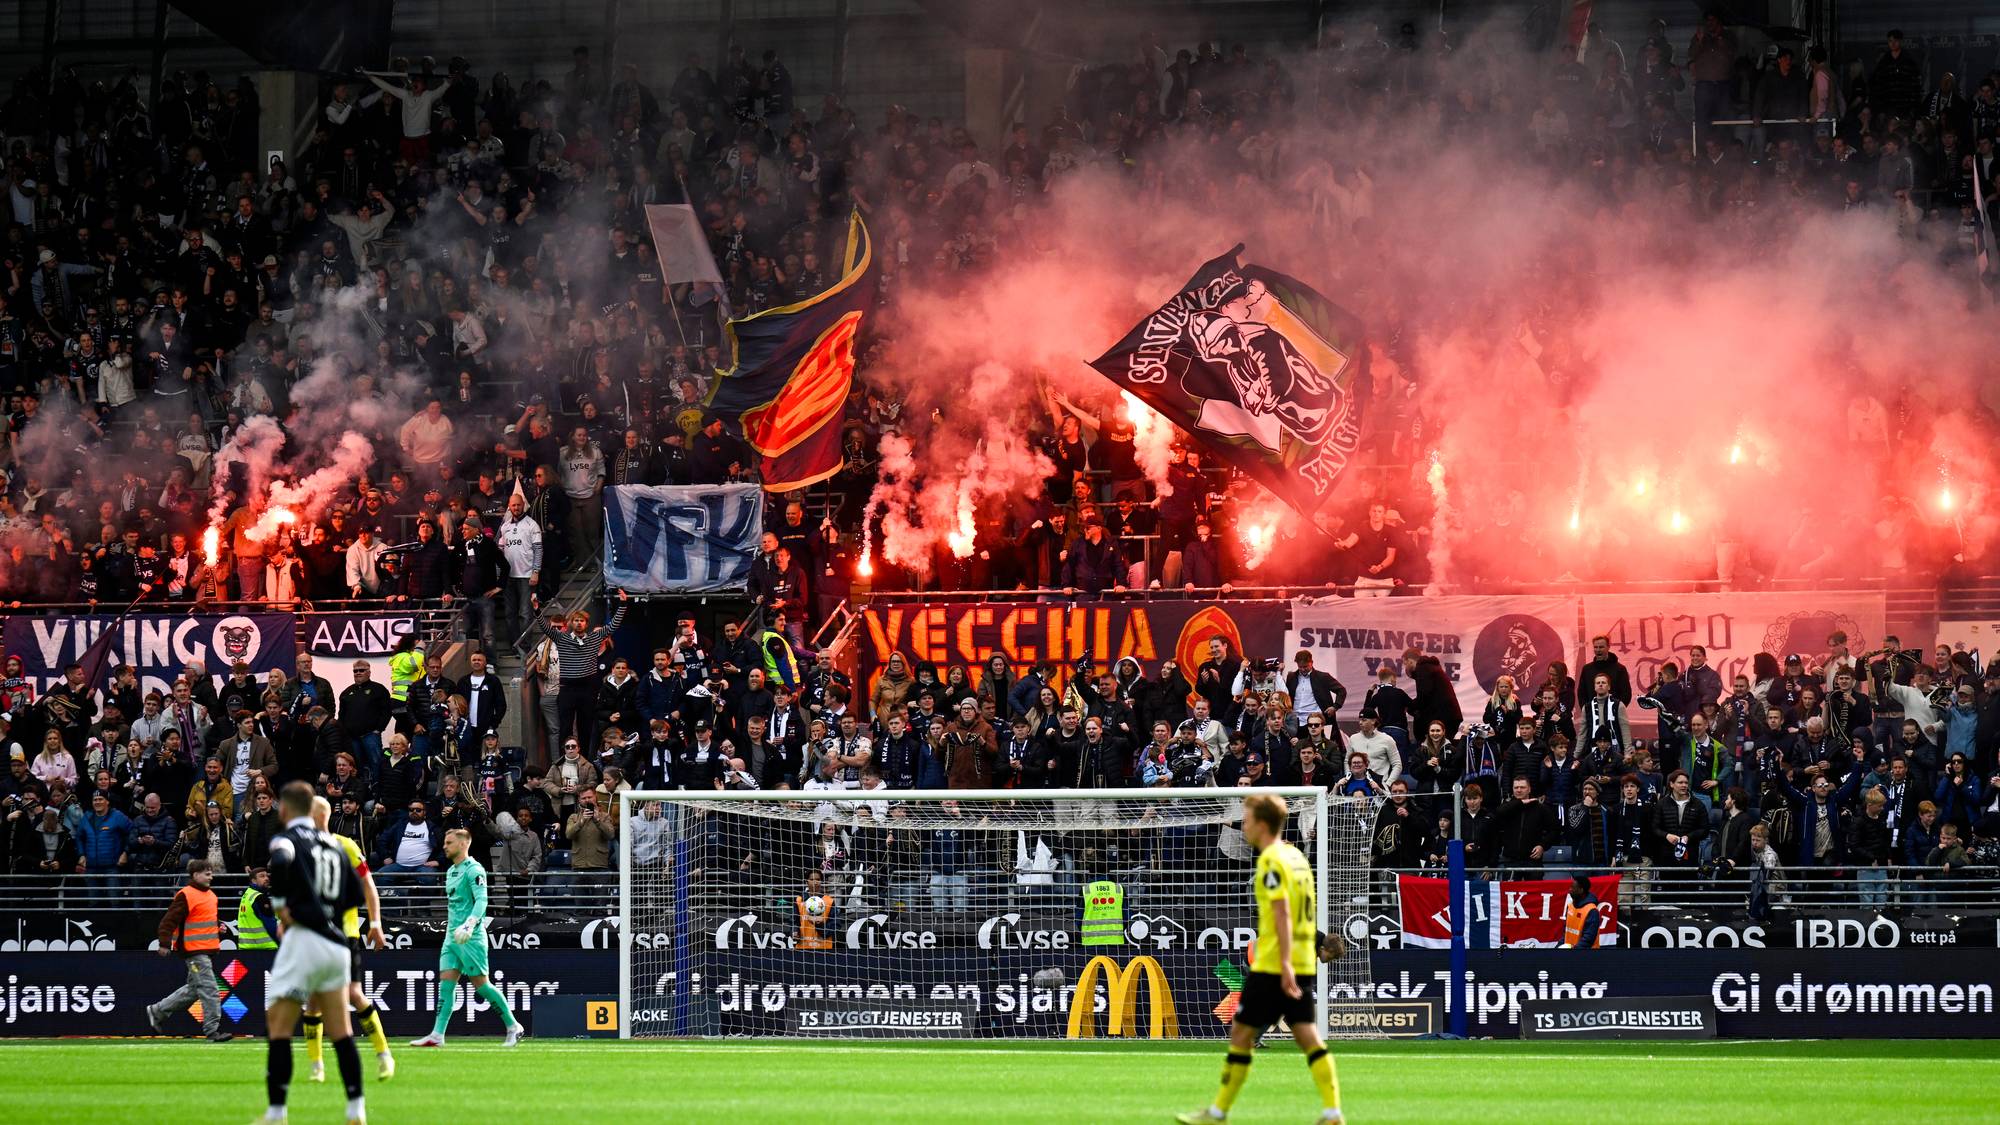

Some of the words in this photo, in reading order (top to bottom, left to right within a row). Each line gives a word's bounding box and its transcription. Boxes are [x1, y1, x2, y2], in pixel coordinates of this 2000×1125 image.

[569, 462, 590, 472] Lyse
[31, 618, 207, 668] VIKING
[863, 607, 1158, 662] VECCHIA
[1300, 627, 1462, 654] STAVANGER
[1364, 657, 1461, 682] YNE
[311, 845, 341, 899] 10
[1431, 890, 1613, 934] VIKIG
[488, 933, 541, 949] yse
[868, 927, 937, 949] Lyse
[1001, 926, 1070, 949] Lyse
[1910, 932, 1937, 943] tett
[1939, 930, 1956, 945] på
[1328, 971, 1427, 998] orsk
[1711, 972, 1760, 1013] Gi
[1775, 972, 1993, 1015] drømmen
[995, 973, 1107, 1024] sjans
[595, 1007, 609, 1025] B
[631, 1010, 668, 1022] ACKE
[799, 1012, 819, 1026] TS
[824, 1010, 962, 1026] BYGGTJENESTER
[1329, 1013, 1418, 1027] SØRVEST
[1534, 1013, 1557, 1028] TS
[1560, 1010, 1703, 1028] BYGGTJENESTER
